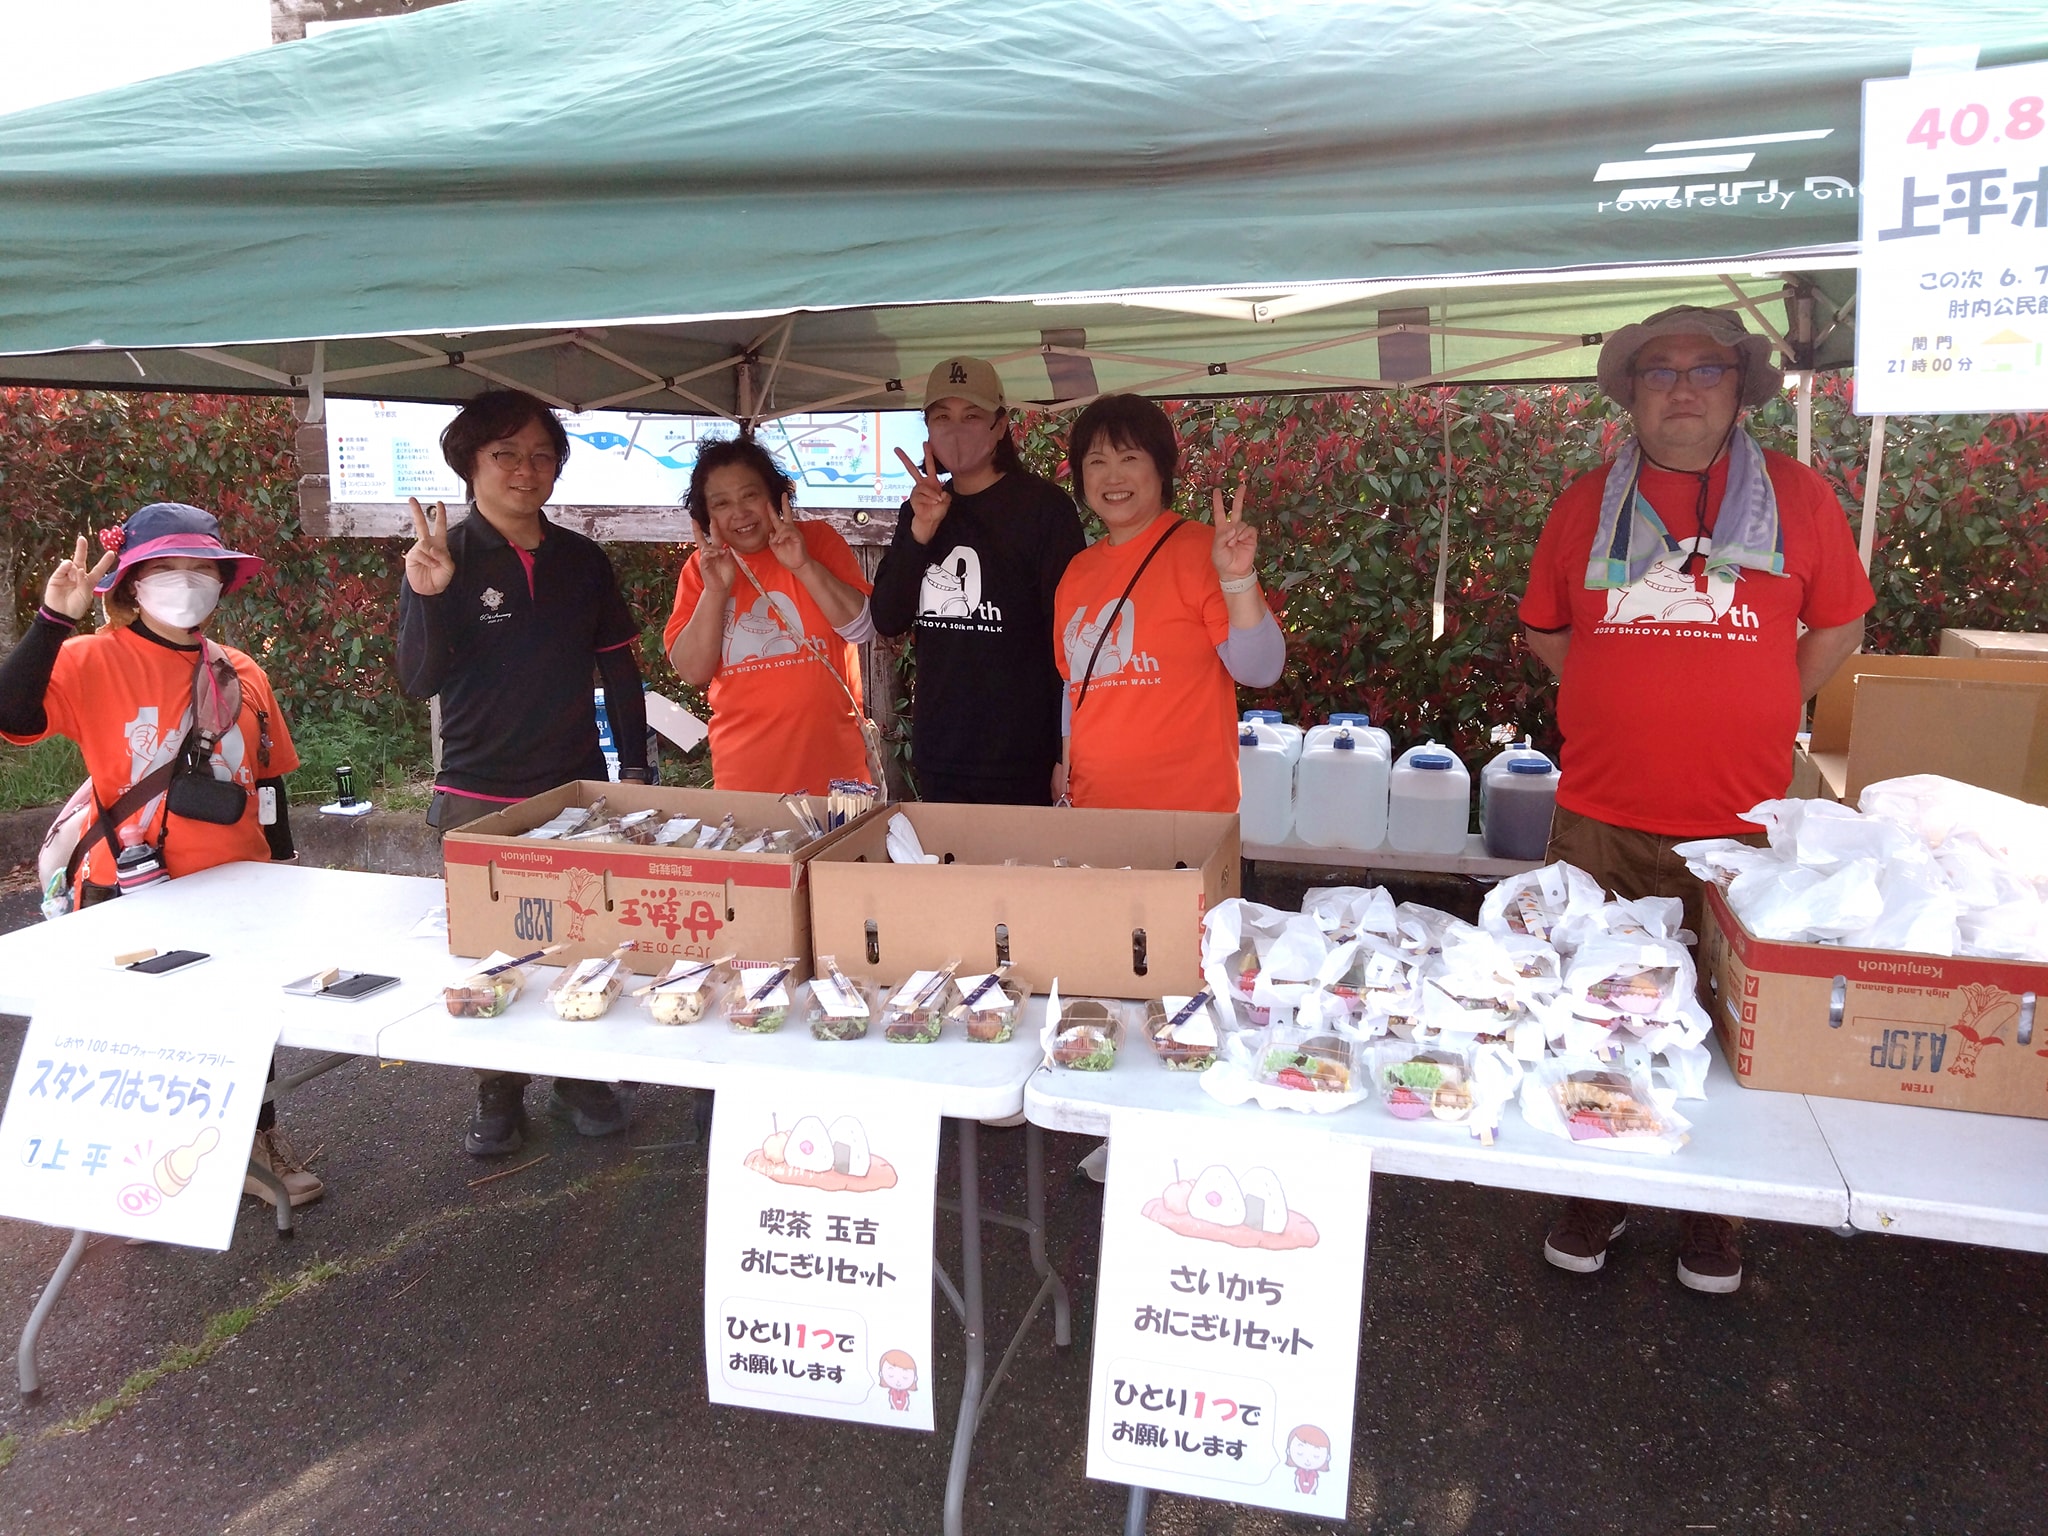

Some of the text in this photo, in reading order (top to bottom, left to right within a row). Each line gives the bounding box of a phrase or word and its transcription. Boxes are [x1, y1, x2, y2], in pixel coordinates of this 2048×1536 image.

[1919, 269, 1984, 291] この次
[949, 361, 968, 384] LA
[977, 625, 1003, 633] WALK
[1618, 627, 1671, 637] SHIOYA
[1675, 630, 1723, 640] 100km
[1727, 633, 1759, 643] WALK
[1131, 677, 1161, 686] WALK
[500, 851, 553, 865] Kanjukuoh
[648, 862, 693, 877] 高地栽培
[514, 896, 553, 942] A28P
[618, 887, 723, 943] 甘熟王
[1858, 959, 1944, 980] Kanjukuoh
[1855, 983, 1950, 999] High Land Banana
[1870, 1028, 1948, 1073] A19P
[1901, 1082, 1934, 1094] ITEM
[122, 1188, 159, 1211] OK
[760, 1207, 880, 1245] 喫茶 玉吉
[741, 1247, 897, 1288] おにぎりセット
[1170, 1264, 1284, 1306] さいかち
[726, 1316, 855, 1353] ひとり1つで
[1134, 1304, 1314, 1356] おにぎりセット
[729, 1352, 846, 1384] お願いします
[1113, 1379, 1262, 1427] ひとり1つで
[1111, 1420, 1247, 1461] お願いします
